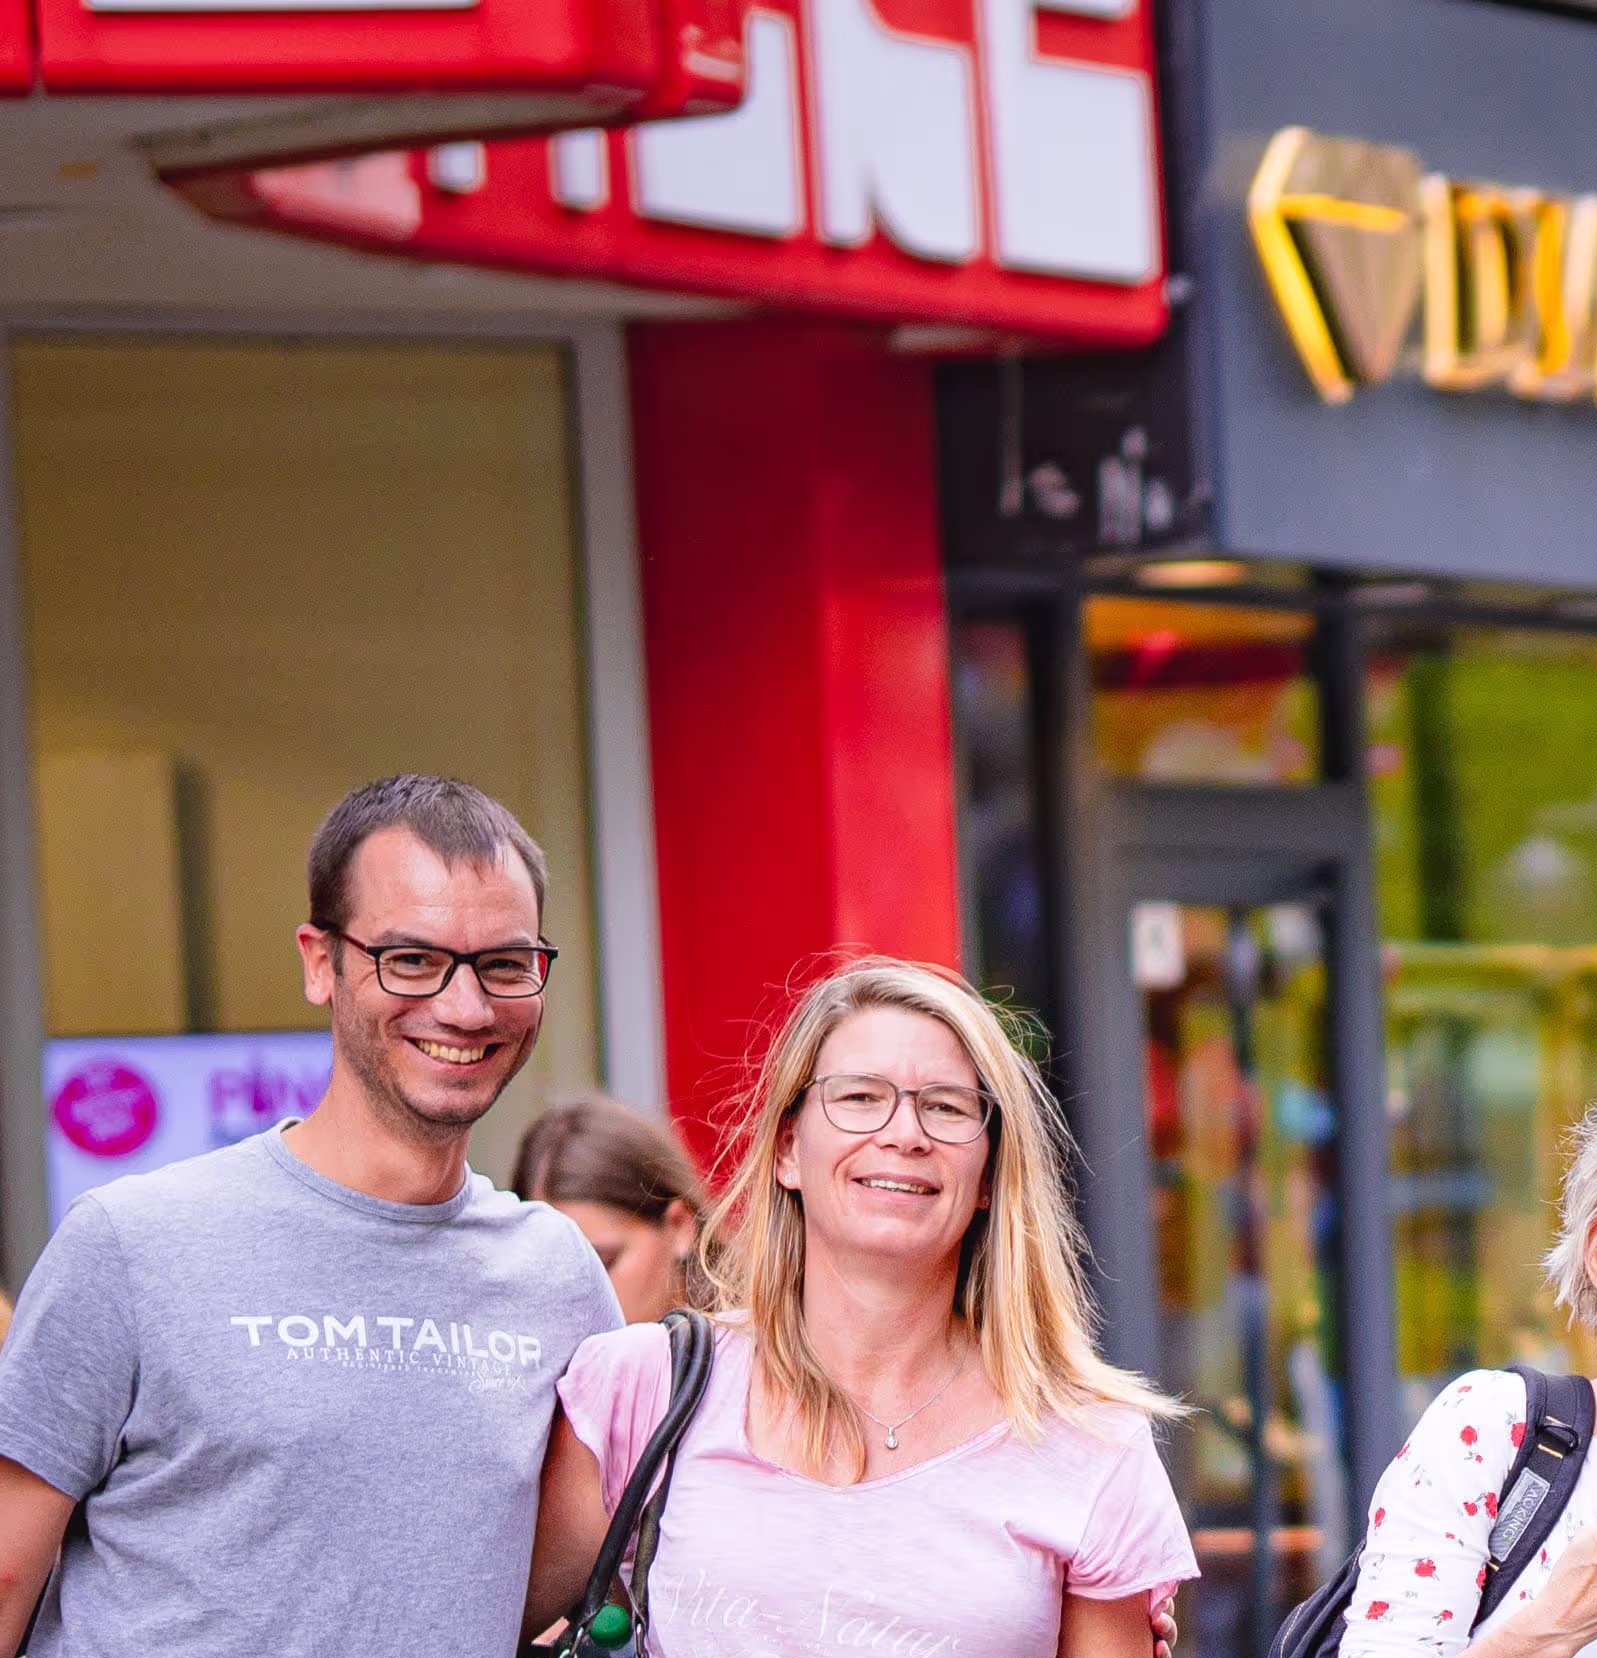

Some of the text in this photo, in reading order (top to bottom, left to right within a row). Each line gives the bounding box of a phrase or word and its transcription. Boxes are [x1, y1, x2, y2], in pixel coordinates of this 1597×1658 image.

[229, 1314, 542, 1367] TOM TAILOR
[287, 1346, 512, 1377] AUTHENTIC VINTAGE
